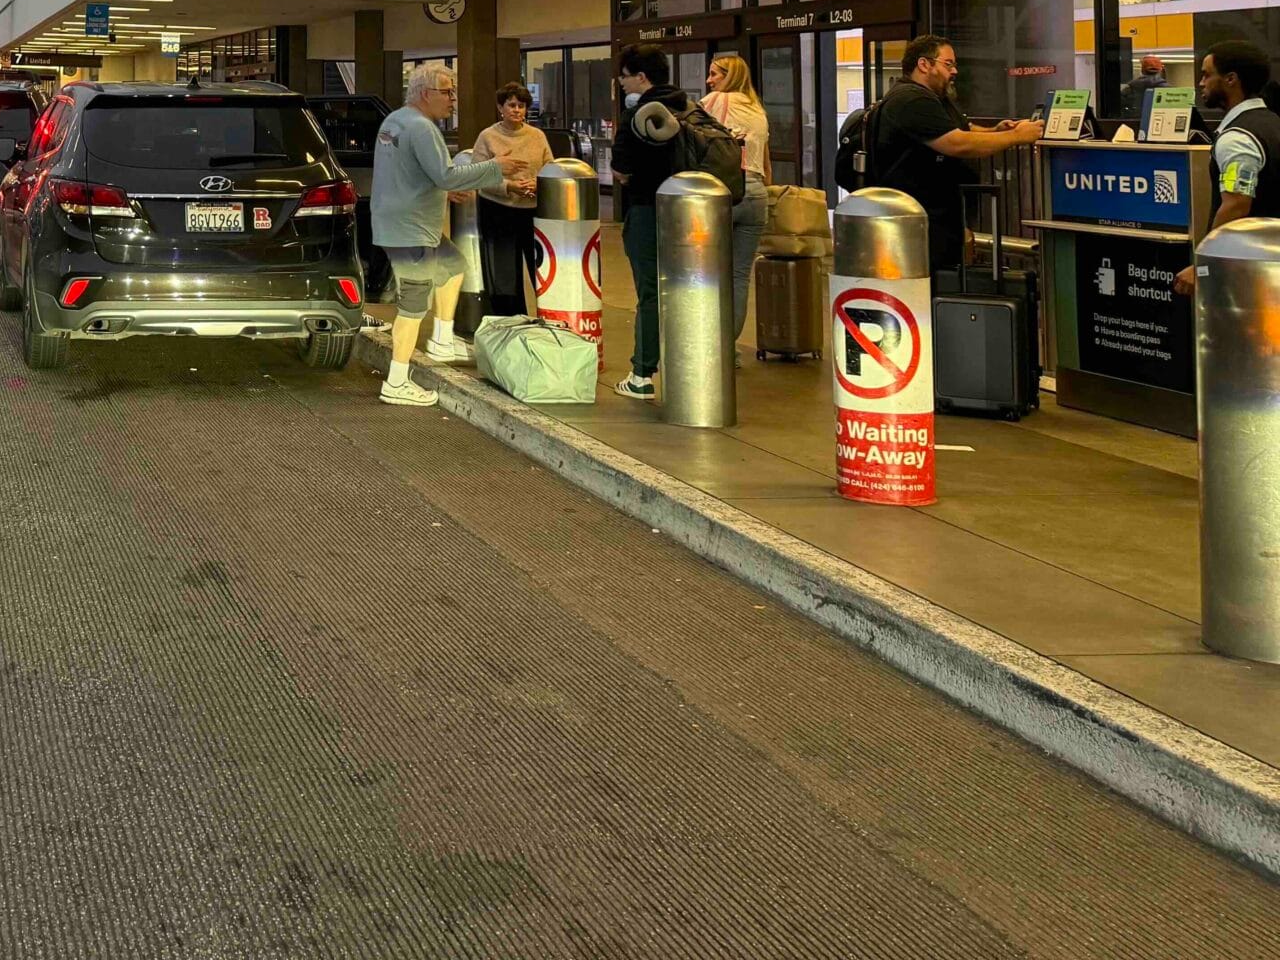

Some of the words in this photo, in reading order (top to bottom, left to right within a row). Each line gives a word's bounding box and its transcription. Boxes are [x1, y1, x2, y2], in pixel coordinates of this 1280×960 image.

[776, 14, 808, 29] Terminal
[808, 13, 815, 26] 7
[829, 8, 853, 23] L2-03
[639, 29, 660, 41] Terminal
[675, 25, 692, 38] L2-04
[14, 53, 23, 65] 7
[1064, 172, 1149, 194] UNITED
[189, 213, 241, 228] 8GVT966
[255, 208, 269, 222] R
[1128, 263, 1148, 282] Bag
[1149, 267, 1174, 284] drop
[1128, 283, 1173, 302] shortcut
[579, 318, 597, 331] No
[1093, 312, 1107, 323] Drop
[1107, 316, 1121, 325] your
[1121, 317, 1136, 328] bags
[1136, 320, 1149, 329] here
[1149, 322, 1155, 330] if
[1100, 326, 1116, 336] Have
[1120, 330, 1146, 344] boarding
[1146, 336, 1161, 344] pass
[1101, 339, 1123, 351] Already
[1123, 343, 1142, 354] added
[1142, 347, 1156, 356] your
[1156, 350, 1172, 360] bags
[836, 422, 843, 435] o
[846, 419, 928, 447] Waiting
[837, 444, 926, 469] ow-Away
[851, 479, 870, 488] CALL
[870, 481, 891, 491] (424)
